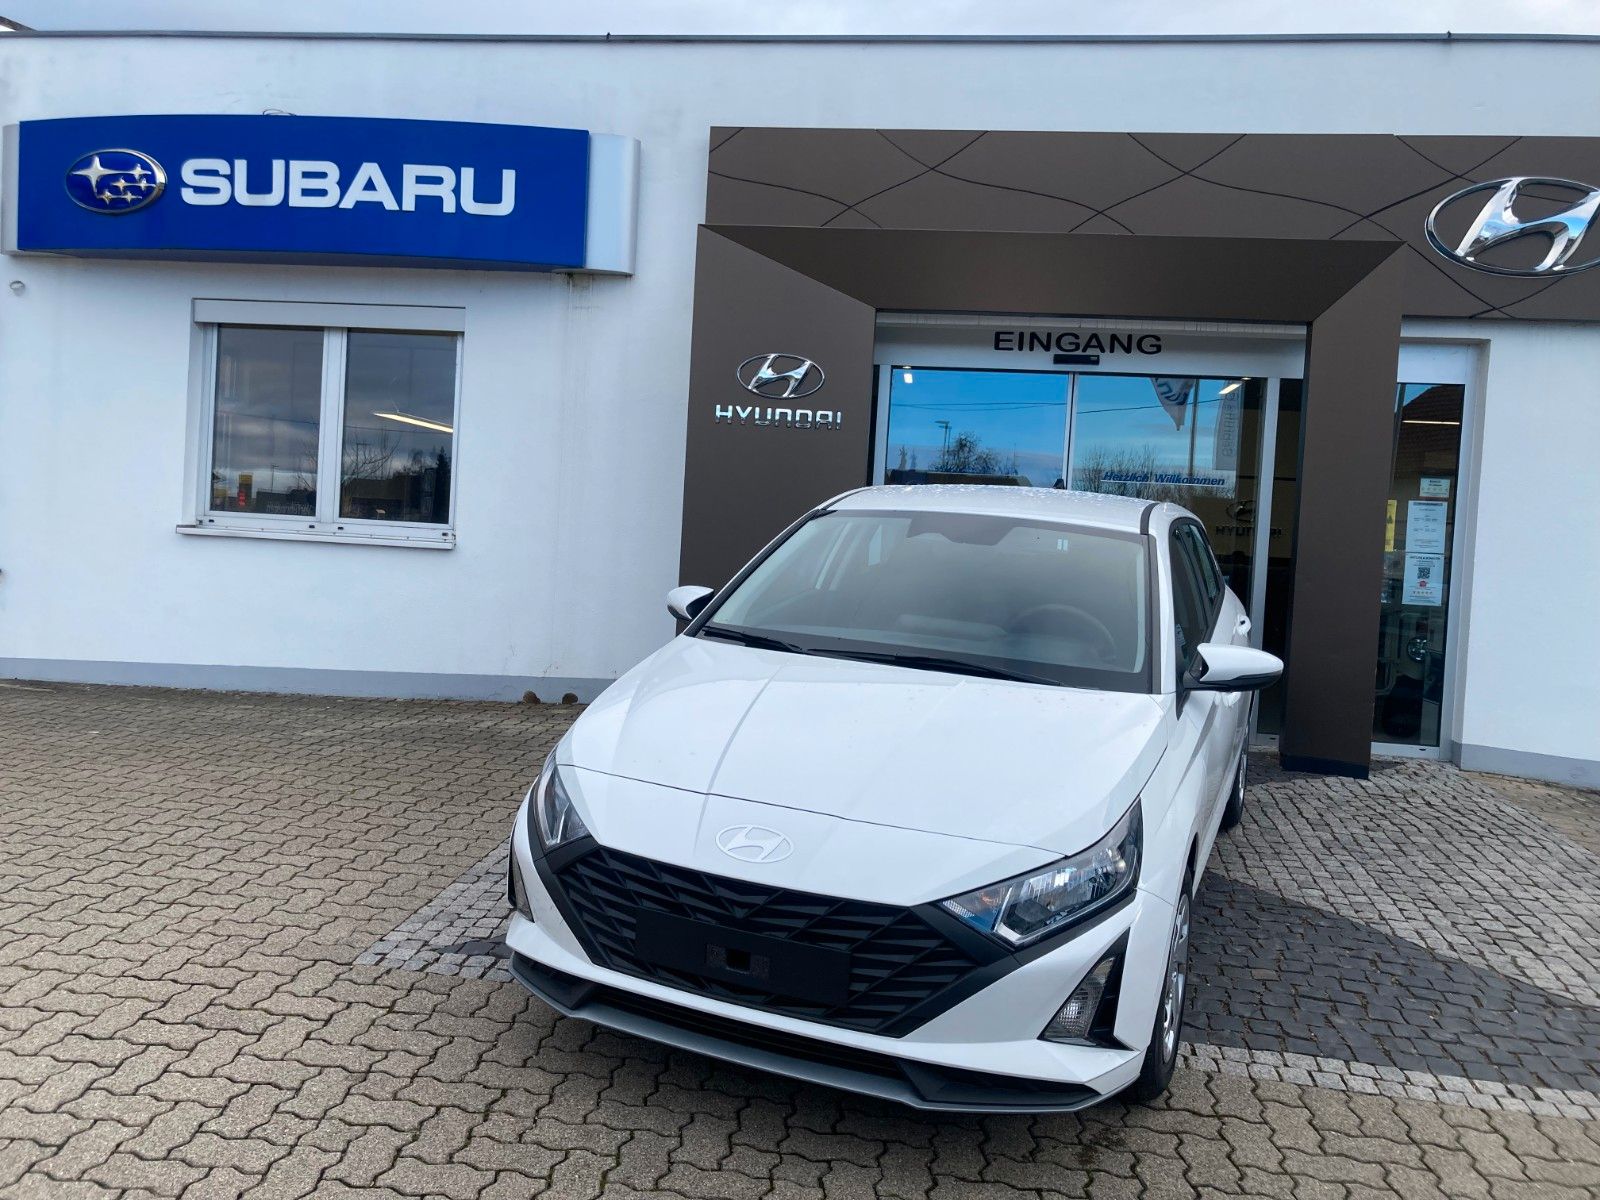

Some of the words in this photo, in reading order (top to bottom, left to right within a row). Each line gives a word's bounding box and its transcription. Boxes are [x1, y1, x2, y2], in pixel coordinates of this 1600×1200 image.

[181, 158, 516, 216] SUBARU
[994, 331, 1162, 354] EINGANG
[715, 404, 842, 430] HYUNDAI
[1103, 471, 1150, 483] Herzlich
[1154, 473, 1226, 486] Willkommen
